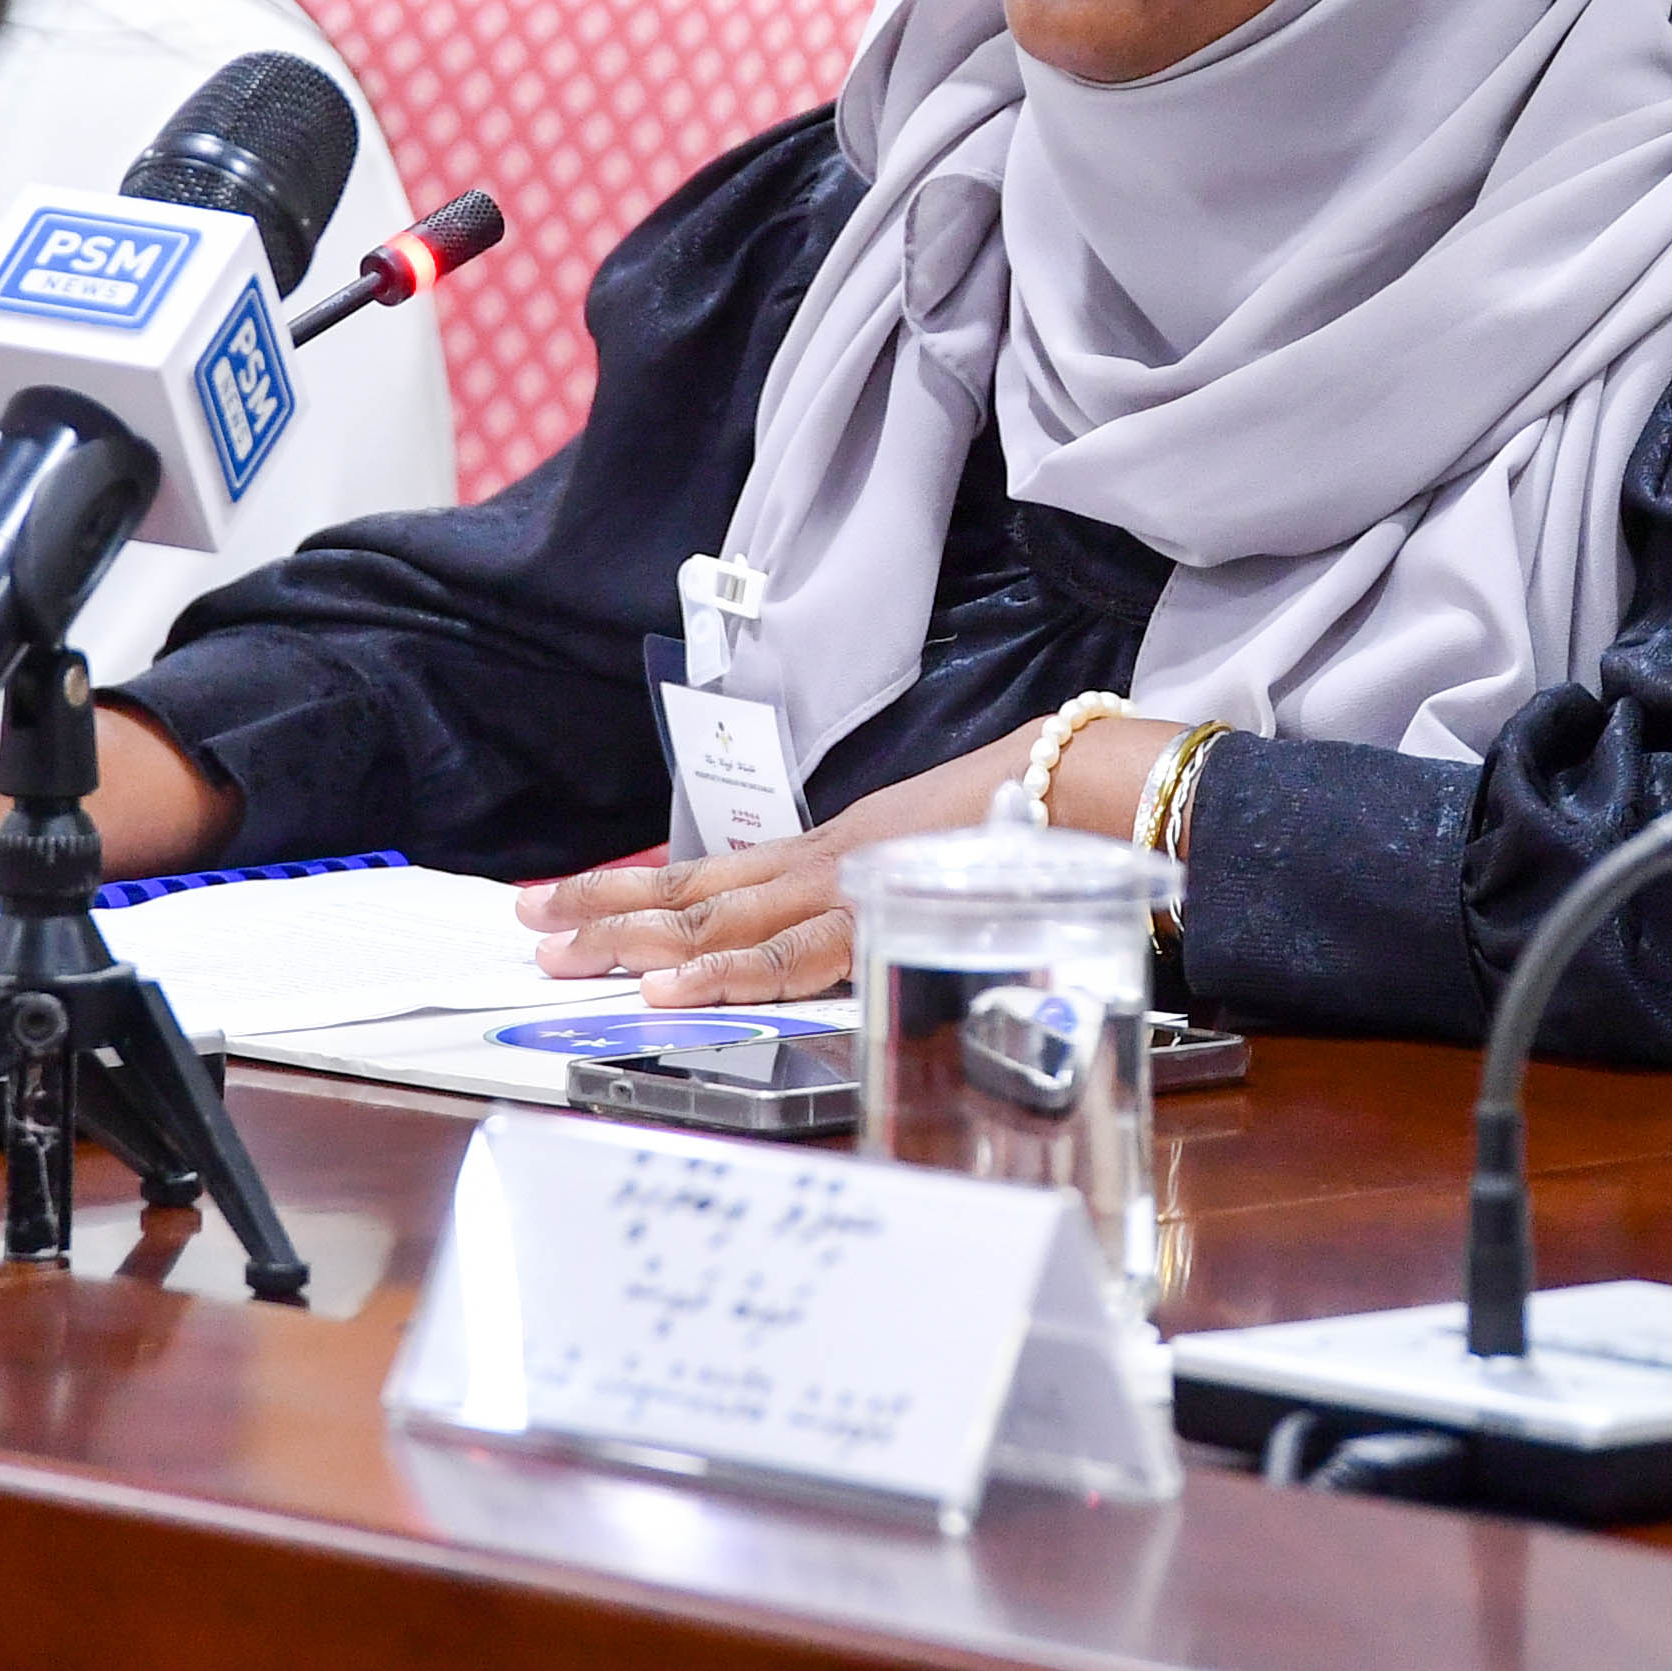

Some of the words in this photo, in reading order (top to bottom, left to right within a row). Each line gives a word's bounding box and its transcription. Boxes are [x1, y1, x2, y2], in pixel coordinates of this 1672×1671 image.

[35, 228, 163, 281] PSM
[42, 274, 122, 298] NEWS
[227, 316, 278, 434] PSM
